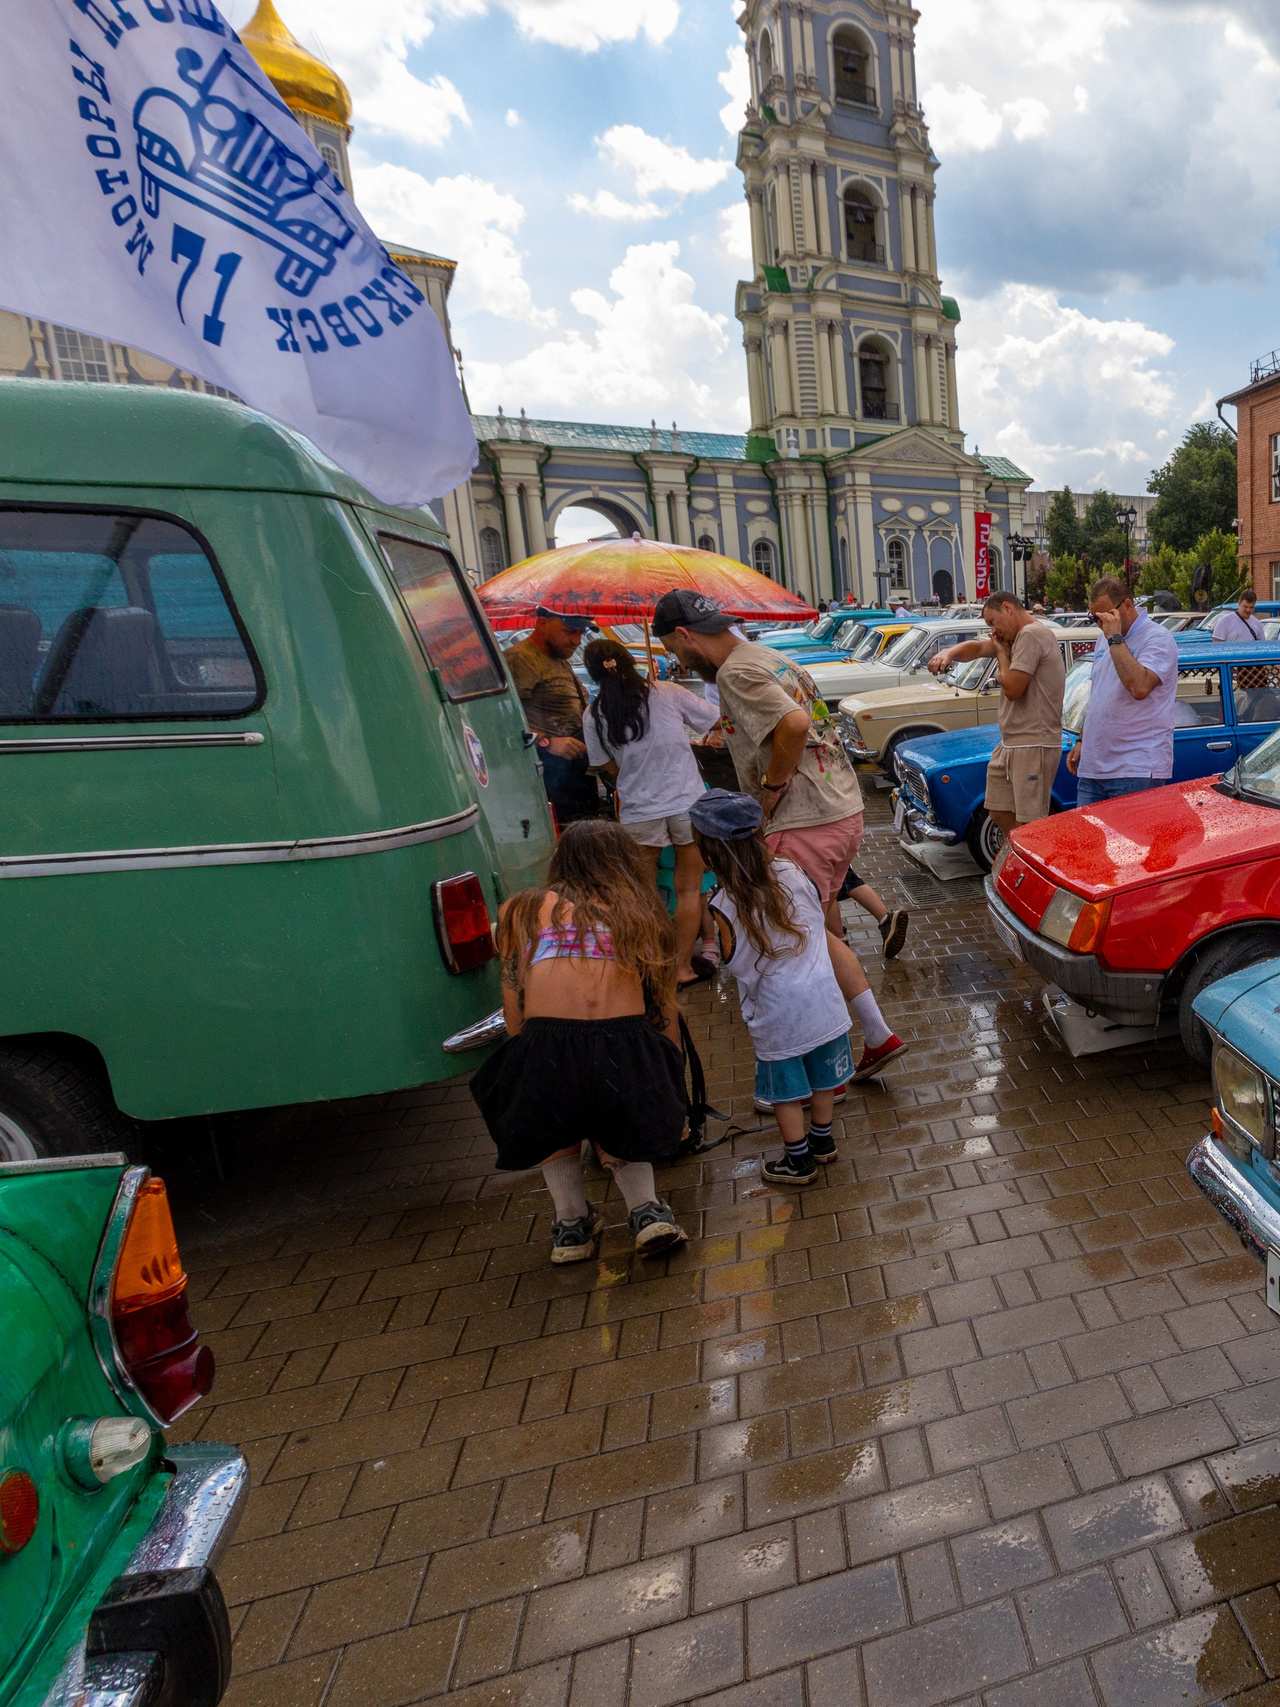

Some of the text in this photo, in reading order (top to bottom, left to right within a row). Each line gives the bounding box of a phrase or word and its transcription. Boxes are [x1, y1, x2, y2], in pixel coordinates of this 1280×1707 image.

[69, 38, 154, 277] МОТОРЫ
[170, 223, 243, 347] 71
[976, 523, 991, 590] autoru
